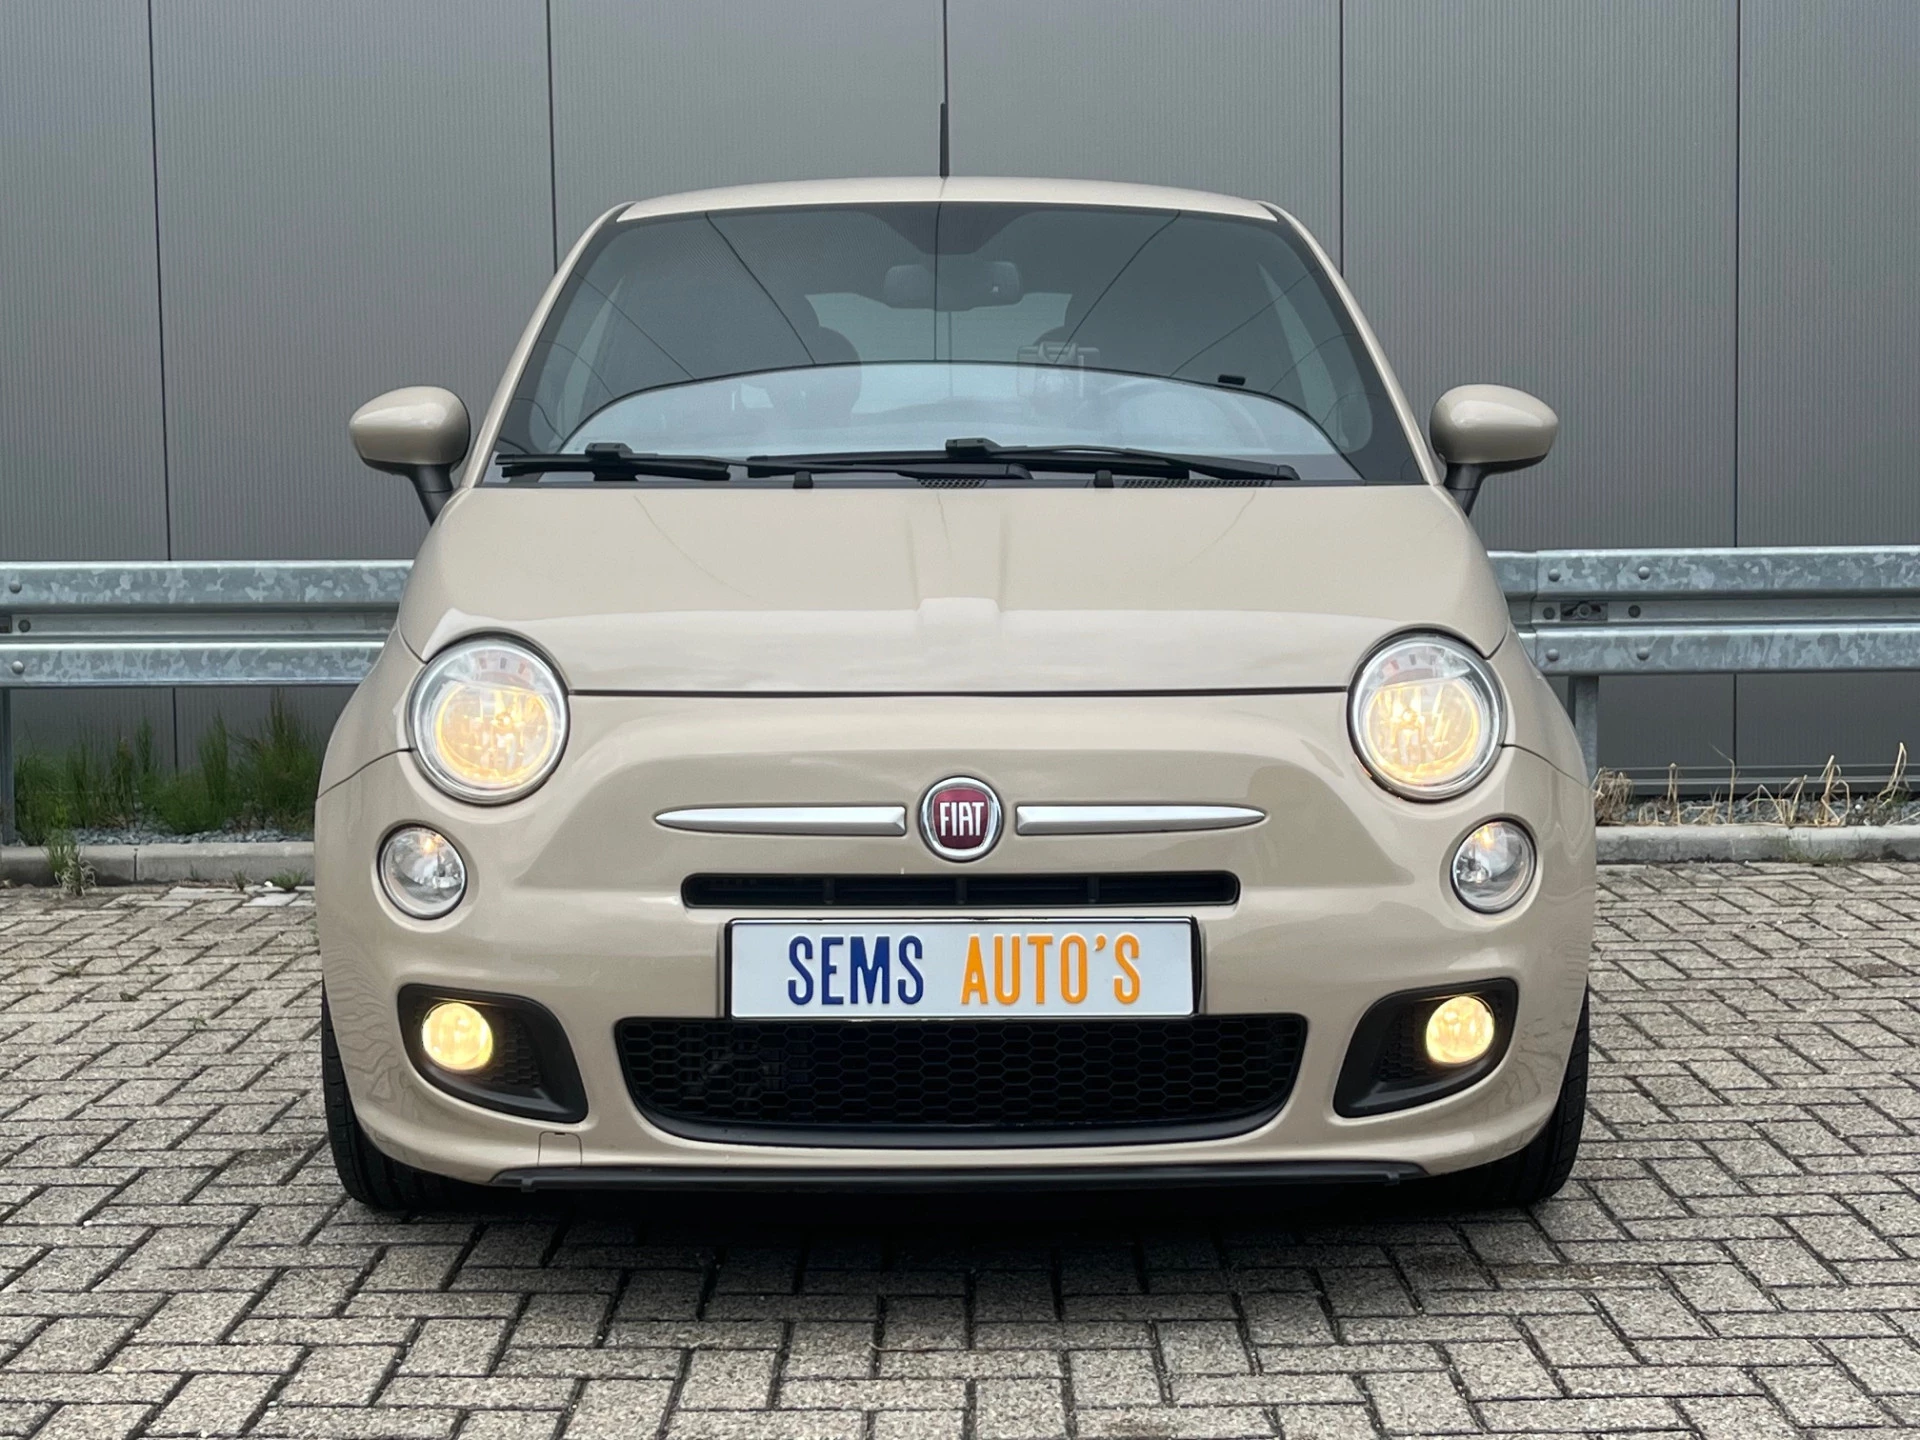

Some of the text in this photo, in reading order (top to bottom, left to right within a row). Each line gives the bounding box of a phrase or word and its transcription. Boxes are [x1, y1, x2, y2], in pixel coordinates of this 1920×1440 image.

[939, 802, 985, 836] FIAT
[788, 934, 1141, 1005] SEMS AUTO'S
